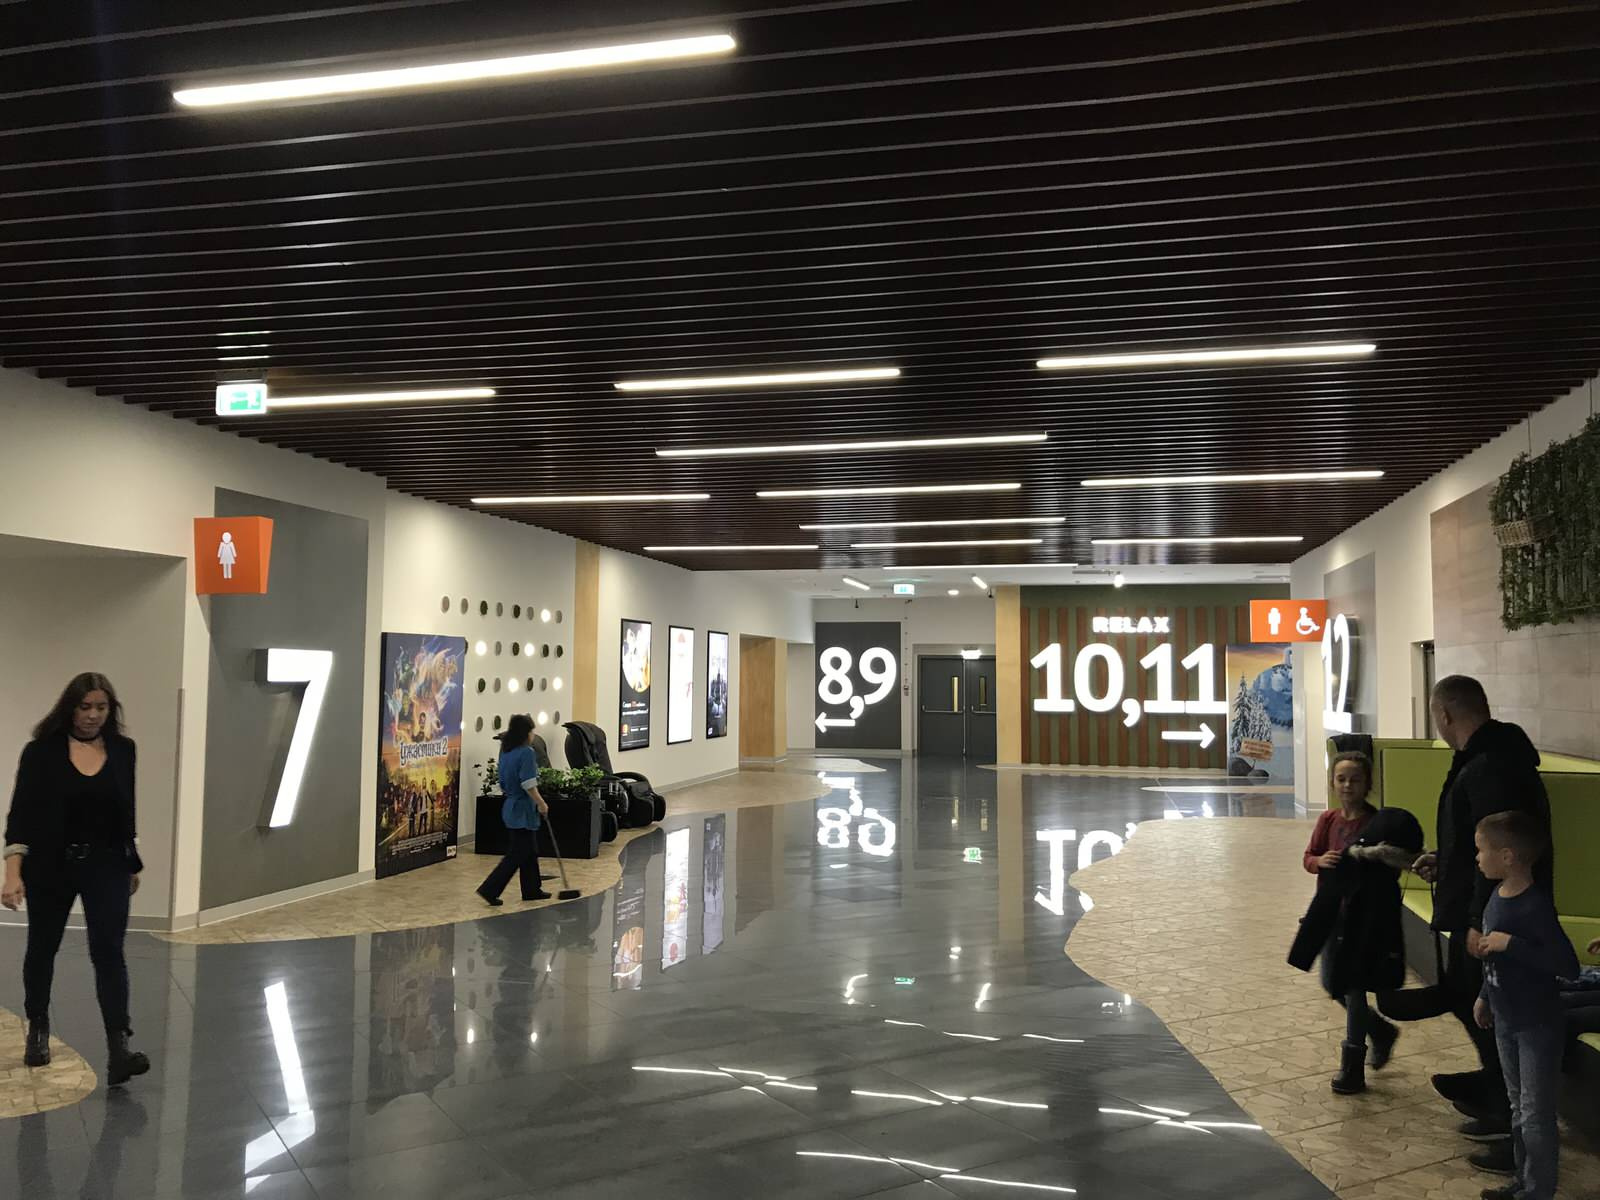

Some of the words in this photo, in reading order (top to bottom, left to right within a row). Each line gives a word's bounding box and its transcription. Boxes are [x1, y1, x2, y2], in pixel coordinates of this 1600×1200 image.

[1092, 616, 1170, 634] RELAX
[818, 646, 897, 719] 8,9
[1030, 643, 1227, 727] 10,11
[267, 648, 333, 828] 7
